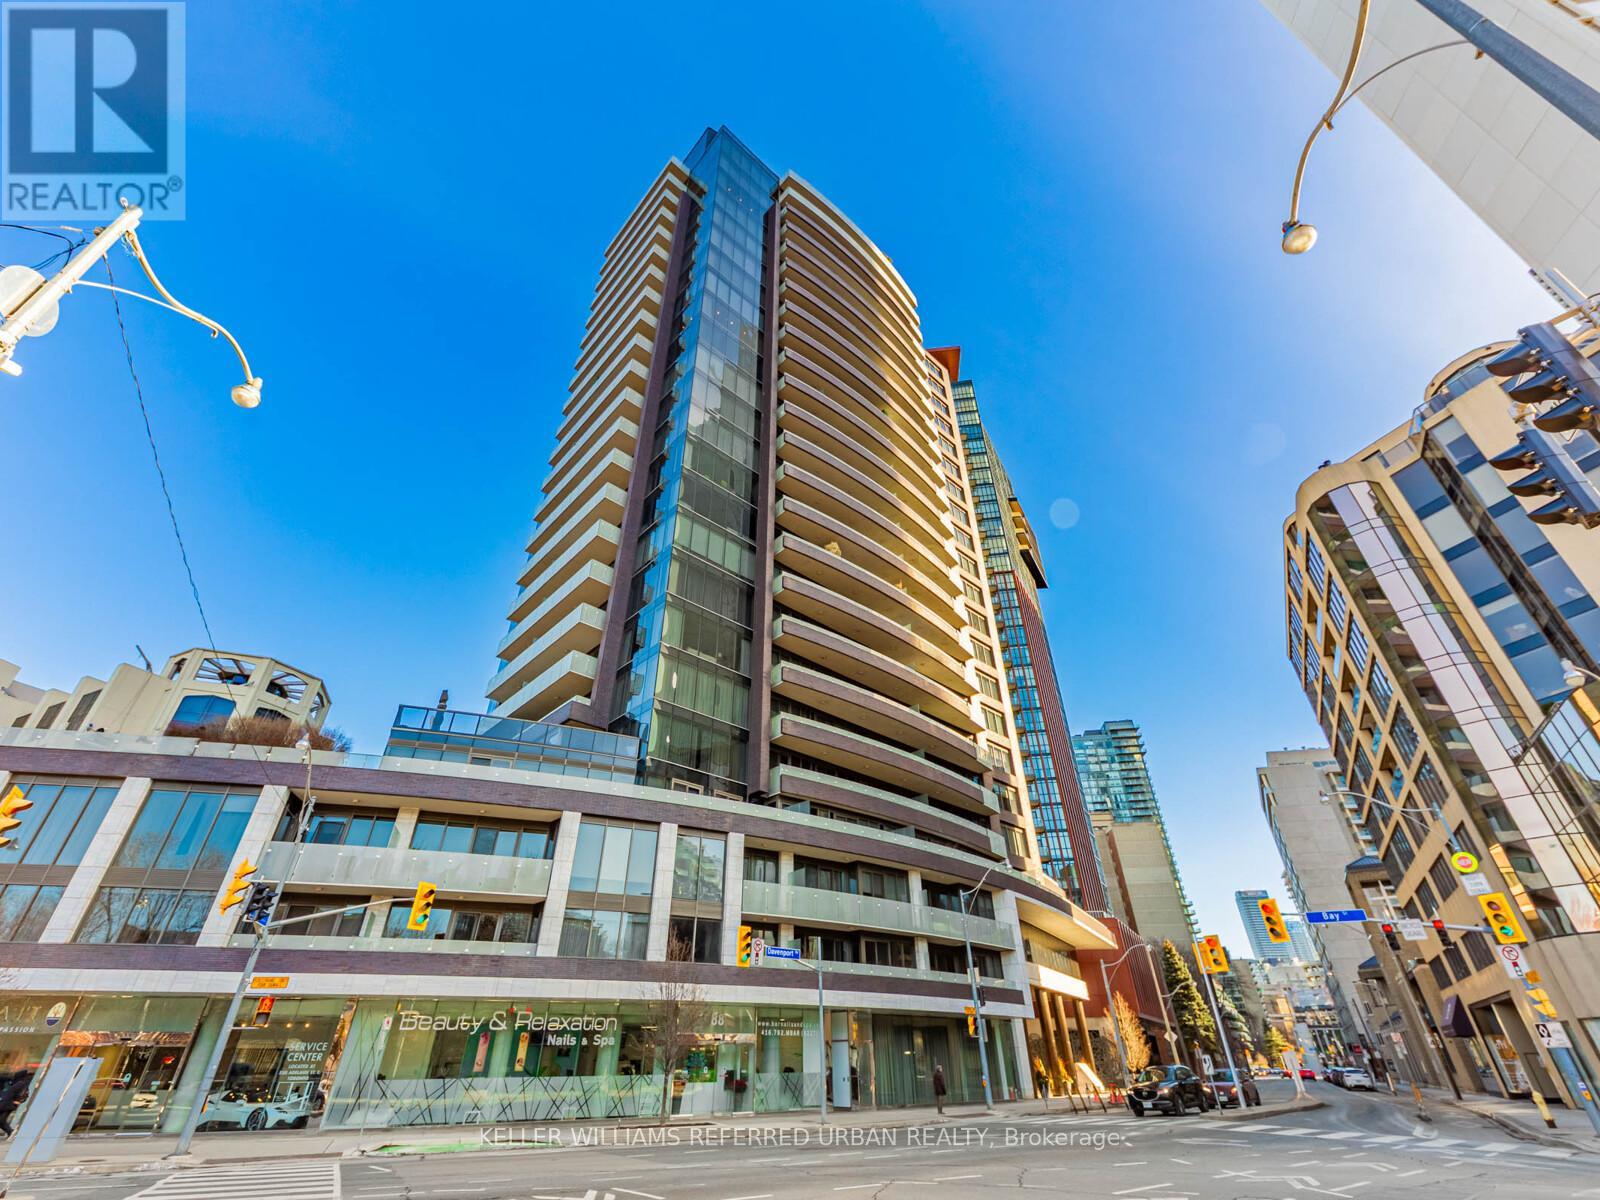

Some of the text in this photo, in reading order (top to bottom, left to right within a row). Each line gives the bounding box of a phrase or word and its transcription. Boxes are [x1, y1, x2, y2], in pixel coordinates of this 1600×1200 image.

[1322, 911, 1340, 922] Bay
[768, 947, 794, 957] Davenport
[400, 1010, 617, 1035] Beauty & Relaxation
[711, 1012, 725, 1026] 88
[289, 1041, 329, 1051] SERVICE
[547, 1034, 577, 1046] Nails
[593, 1034, 615, 1048] Spa
[287, 1052, 323, 1062] CENTER
